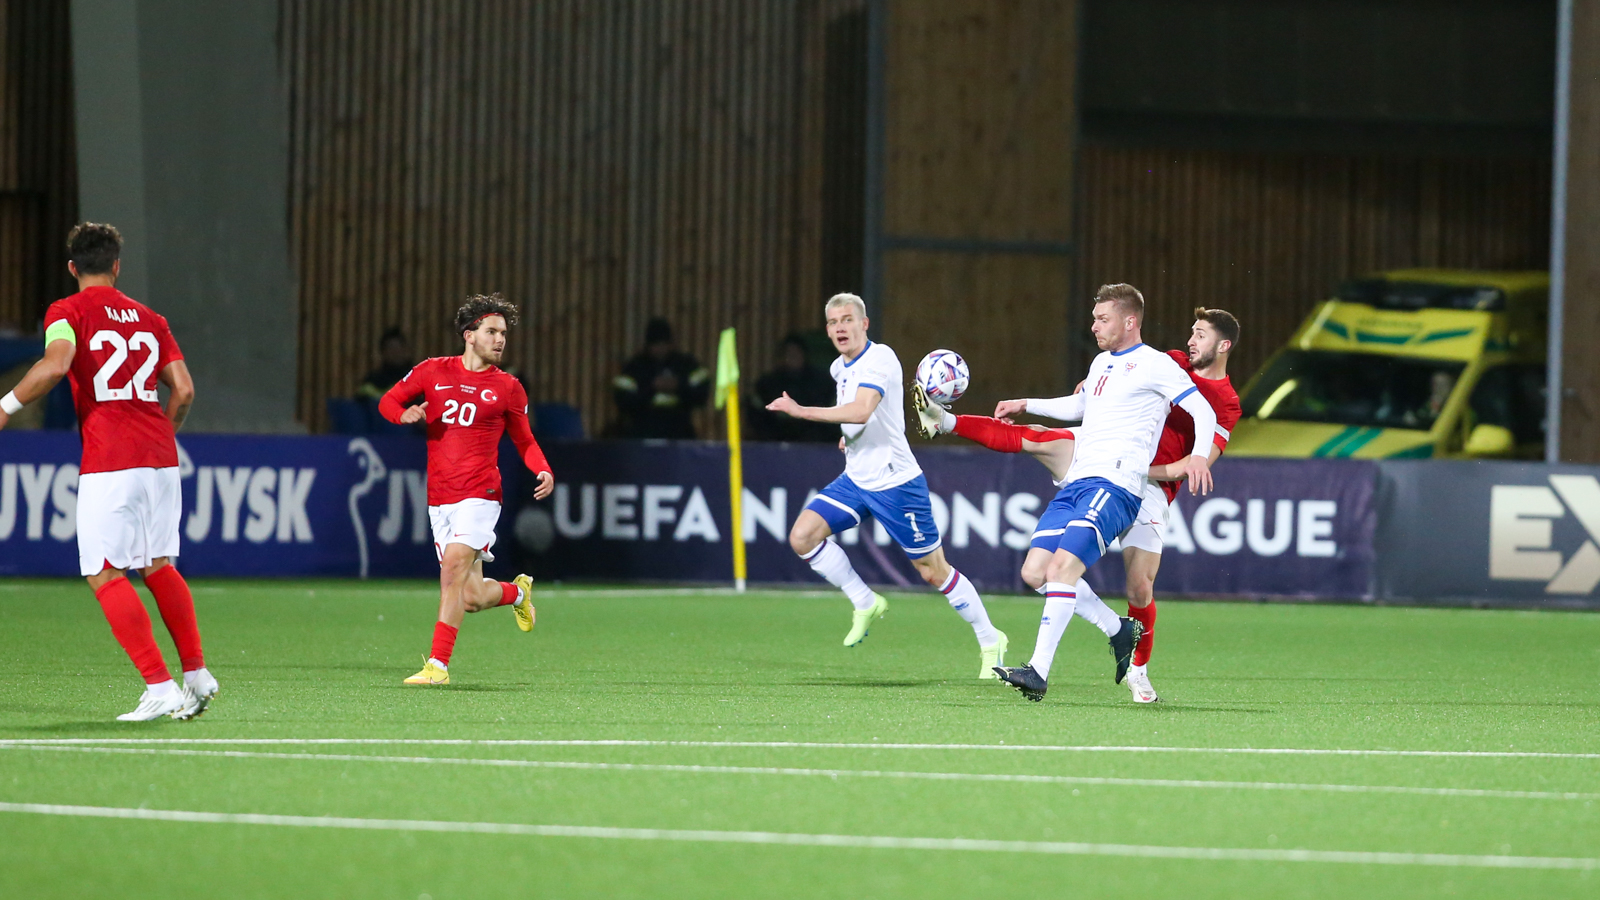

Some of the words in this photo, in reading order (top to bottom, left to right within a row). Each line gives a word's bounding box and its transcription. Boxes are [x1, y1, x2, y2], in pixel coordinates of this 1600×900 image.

[104, 306, 140, 324] KAAN
[89, 329, 160, 402] 22
[1093, 375, 1109, 396] 11
[441, 399, 477, 427] 20
[0, 463, 81, 542] JYS
[186, 466, 316, 543] JYSK
[377, 469, 428, 545] JY
[554, 483, 720, 541] UEFA
[1107, 498, 1337, 557] AGUE
[905, 512, 919, 532] 7
[1089, 488, 1111, 511] 11
